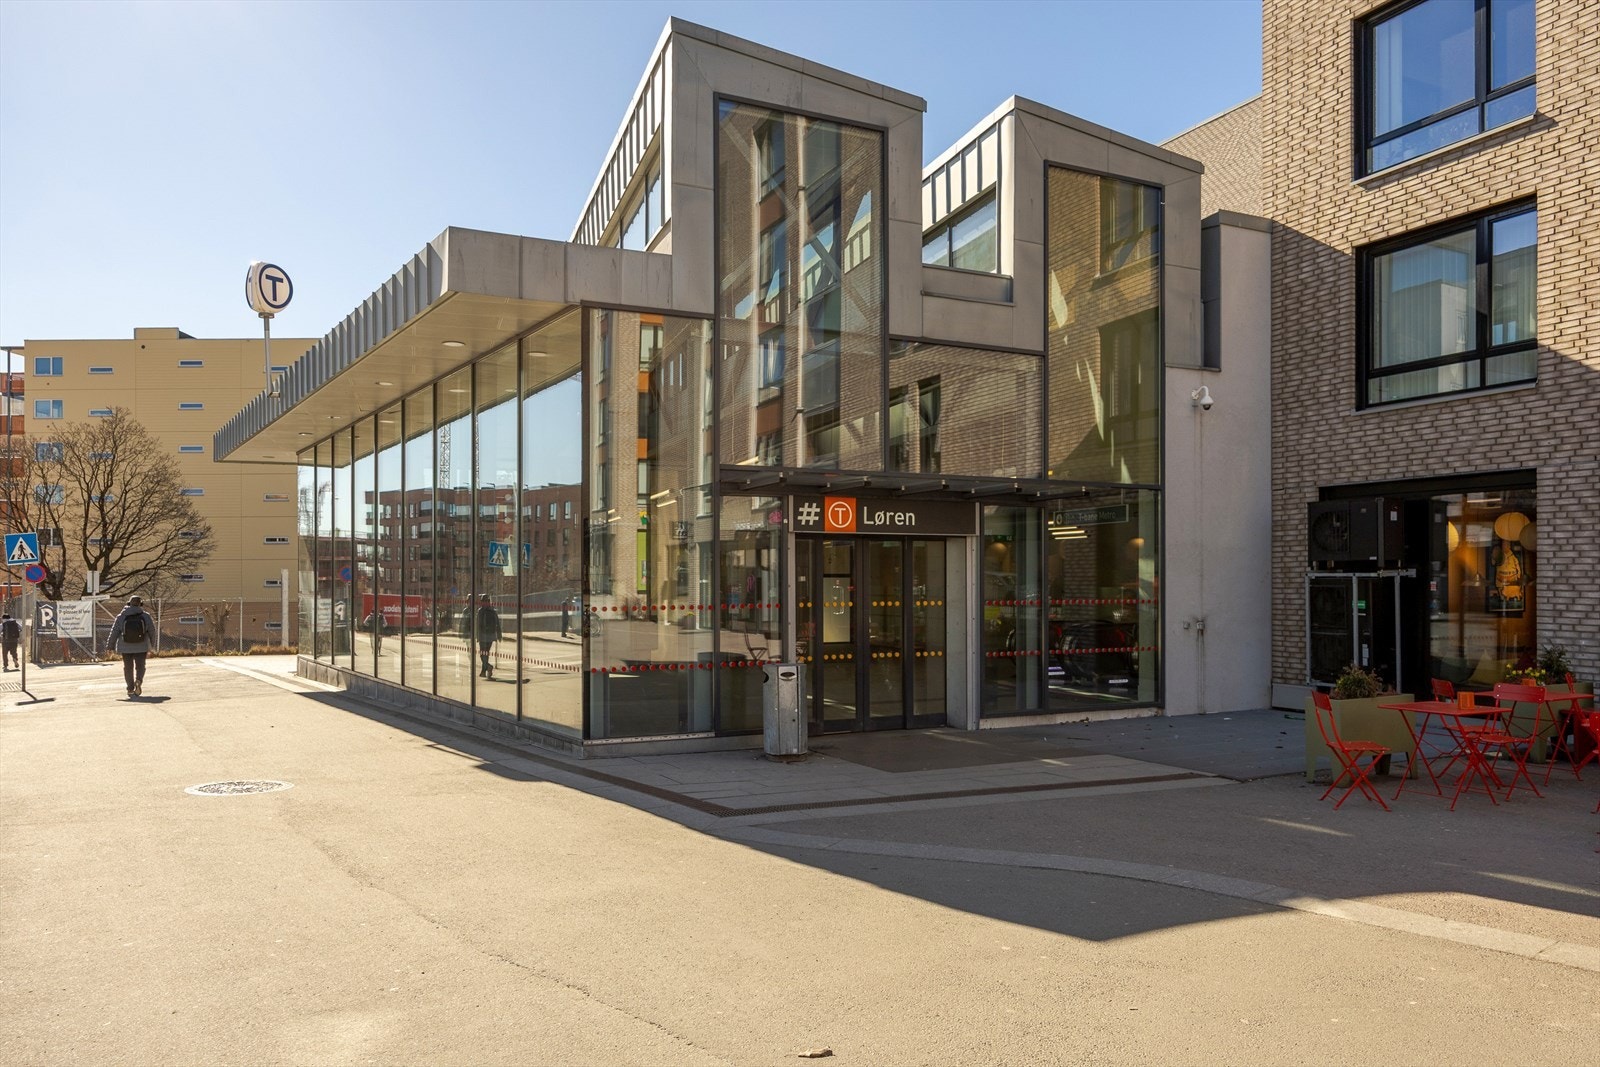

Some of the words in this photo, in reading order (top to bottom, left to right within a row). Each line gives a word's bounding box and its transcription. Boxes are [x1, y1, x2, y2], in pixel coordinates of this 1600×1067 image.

[265, 273, 284, 302] T
[863, 506, 915, 526] Løren
[41, 608, 54, 627] P
